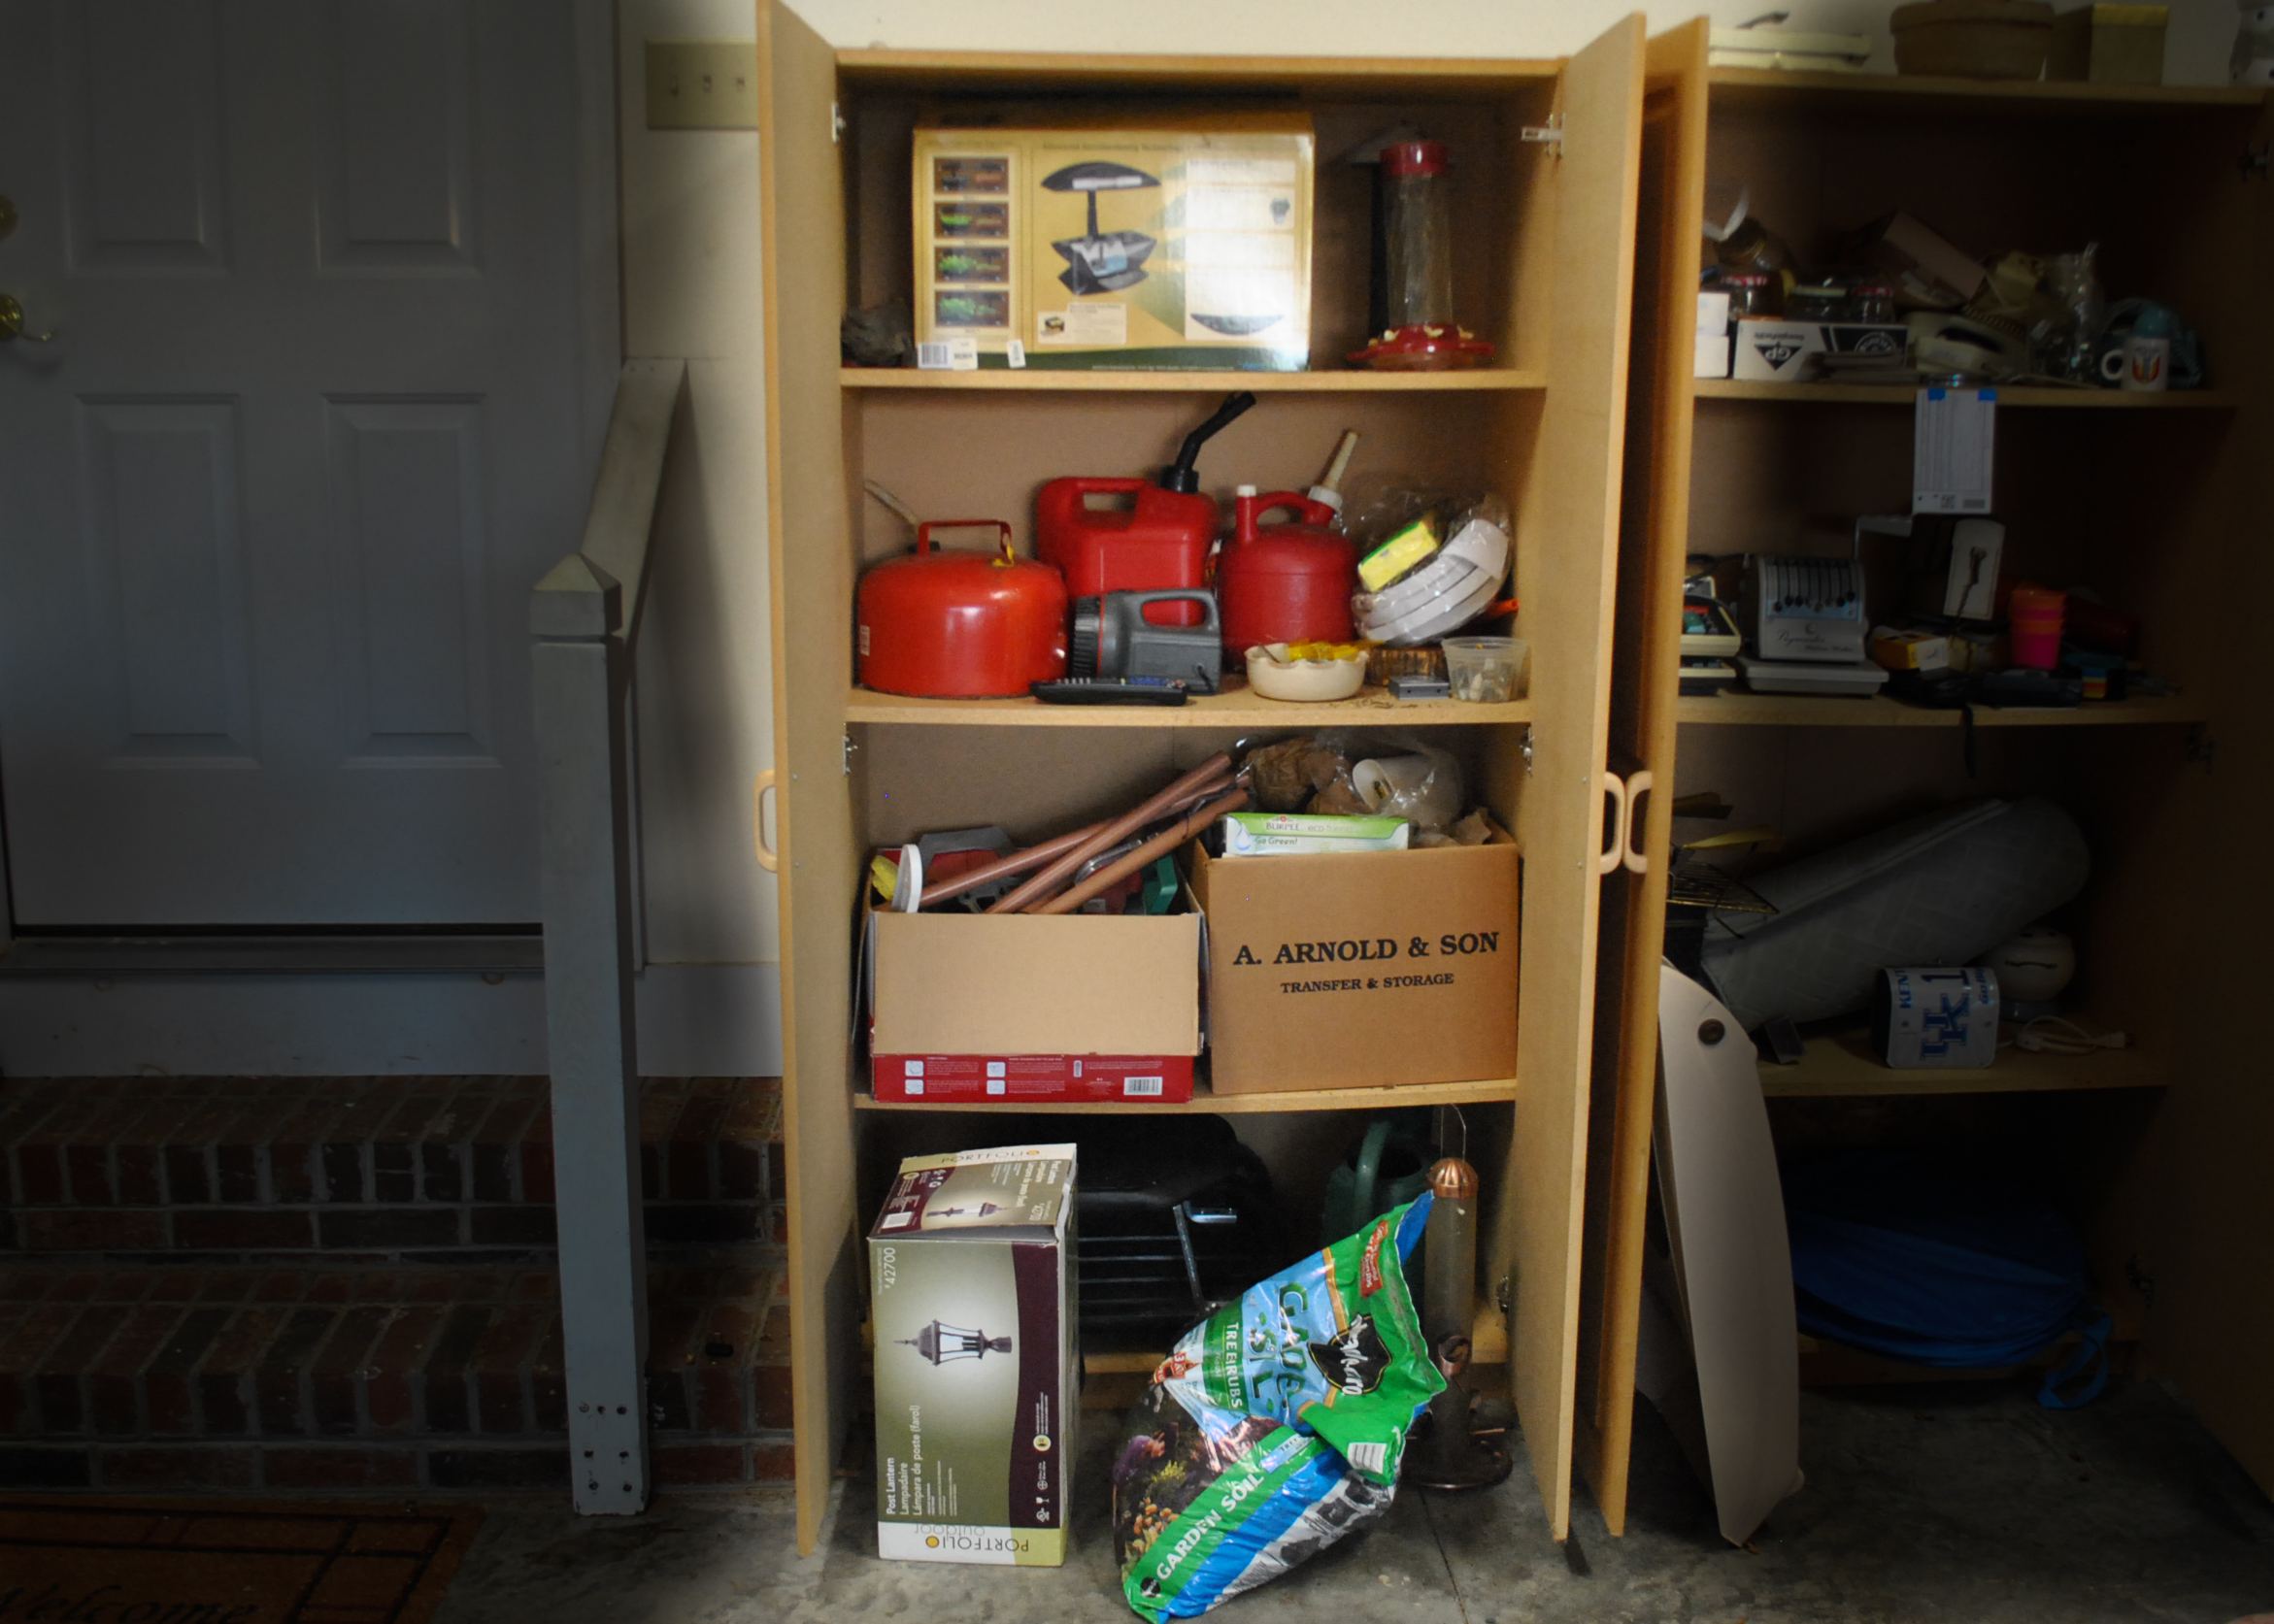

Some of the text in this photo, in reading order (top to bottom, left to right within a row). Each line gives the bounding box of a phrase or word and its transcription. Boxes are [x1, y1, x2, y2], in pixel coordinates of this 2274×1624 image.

[1765, 347, 1791, 362] GP
[1268, 836, 1298, 845] Green!
[1233, 932, 1500, 966] A. ARNOLD & SON
[1281, 974, 1455, 993] TRANSFER & STORAGE
[1920, 993, 1969, 1060] UK
[909, 1405, 922, 1432] (farol)
[912, 1434, 923, 1461] poste
[911, 1463, 921, 1475] de
[886, 1457, 896, 1515] Post Lantern
[898, 1462, 911, 1515] Lampadaire
[914, 1524, 986, 1541] outdoor
[1156, 1508, 1222, 1579] GARDEN
[1221, 1474, 1264, 1512] SOIL
[925, 1535, 1029, 1552] PORTFOLIO
